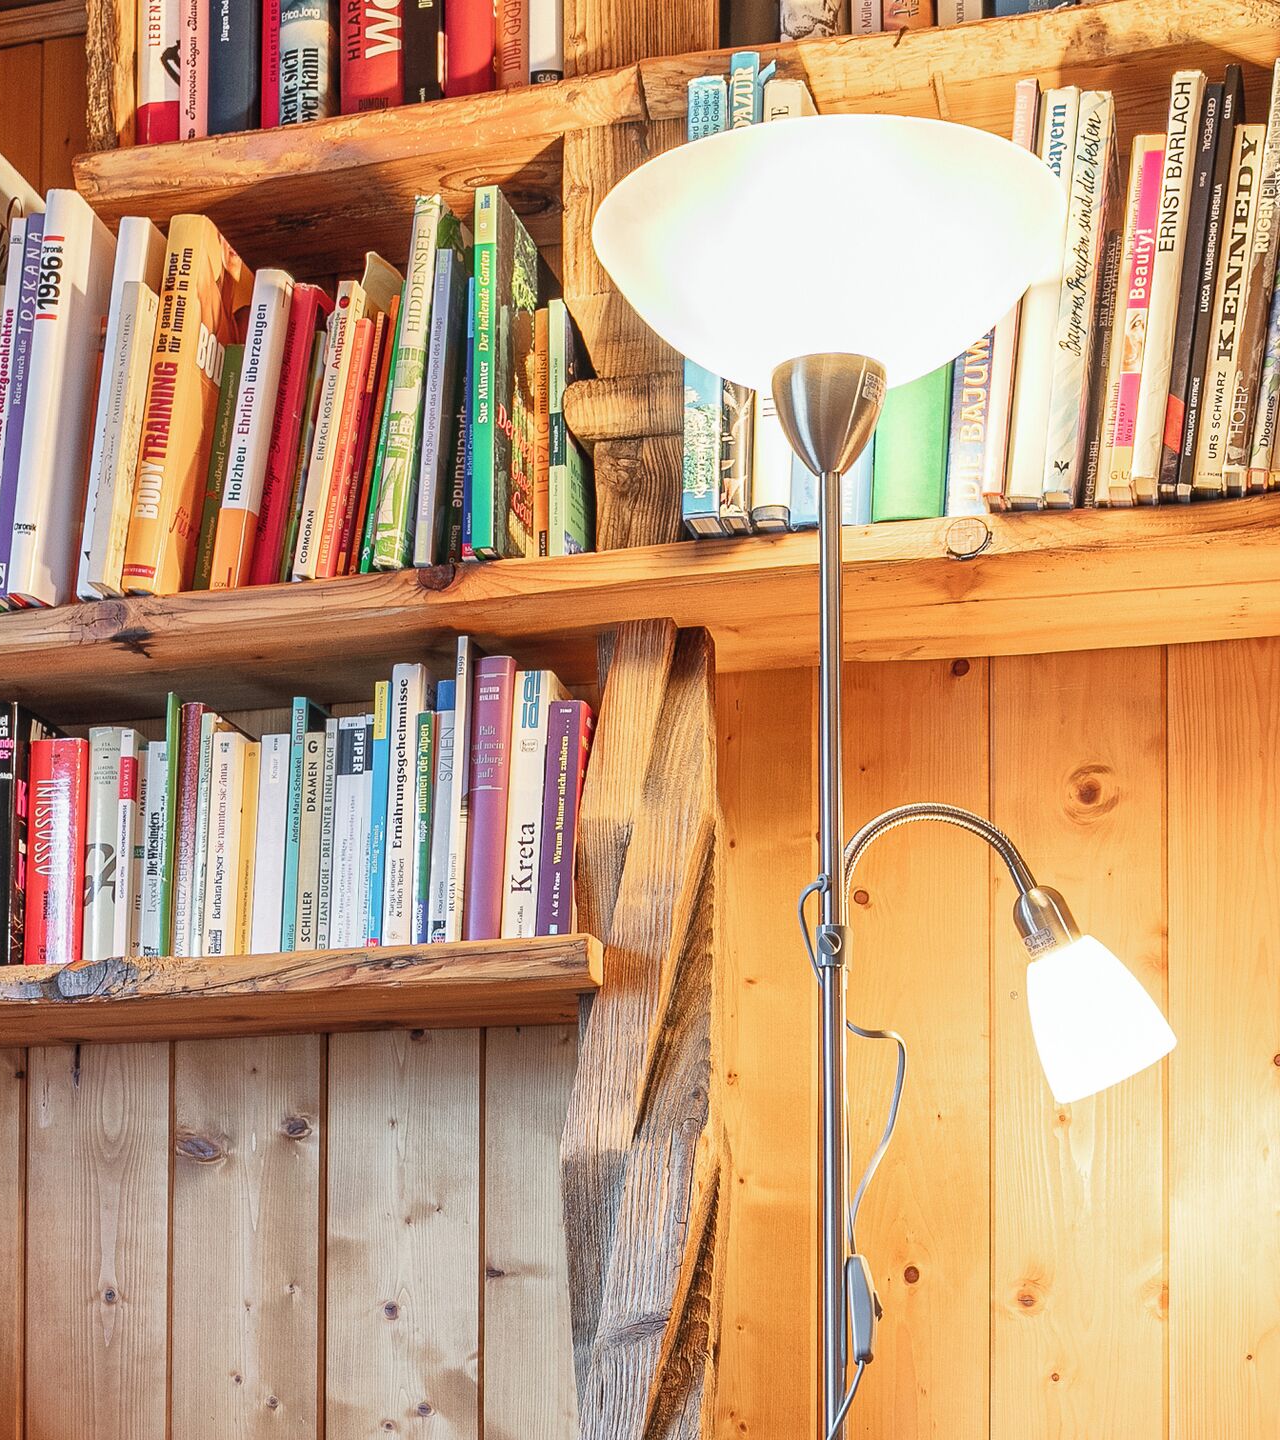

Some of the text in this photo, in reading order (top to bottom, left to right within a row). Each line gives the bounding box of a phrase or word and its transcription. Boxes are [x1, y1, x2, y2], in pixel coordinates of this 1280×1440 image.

[1158, 81, 1191, 253] ERNST BARLACH
[36, 256, 64, 311] 1936
[179, 247, 194, 279] Form
[407, 226, 432, 333] HIDDENSEE
[479, 249, 490, 286] Garten
[1129, 228, 1155, 300] Beauty!
[1217, 130, 1258, 363] KENNEDY
[228, 303, 268, 502] Holzheu Ehrlich überzeugen
[477, 361, 489, 401] Minter
[477, 402, 488, 424] Sue
[1208, 371, 1227, 460] URS SCHWARZ
[135, 360, 179, 520] BODY TRAINING
[300, 509, 315, 565] CORMORAN
[352, 729, 365, 774] PIPER
[391, 678, 409, 850] Ernährungsgeheimnisse
[301, 761, 318, 943] SCHILLER DRAMEN
[510, 821, 536, 895] Kreta
